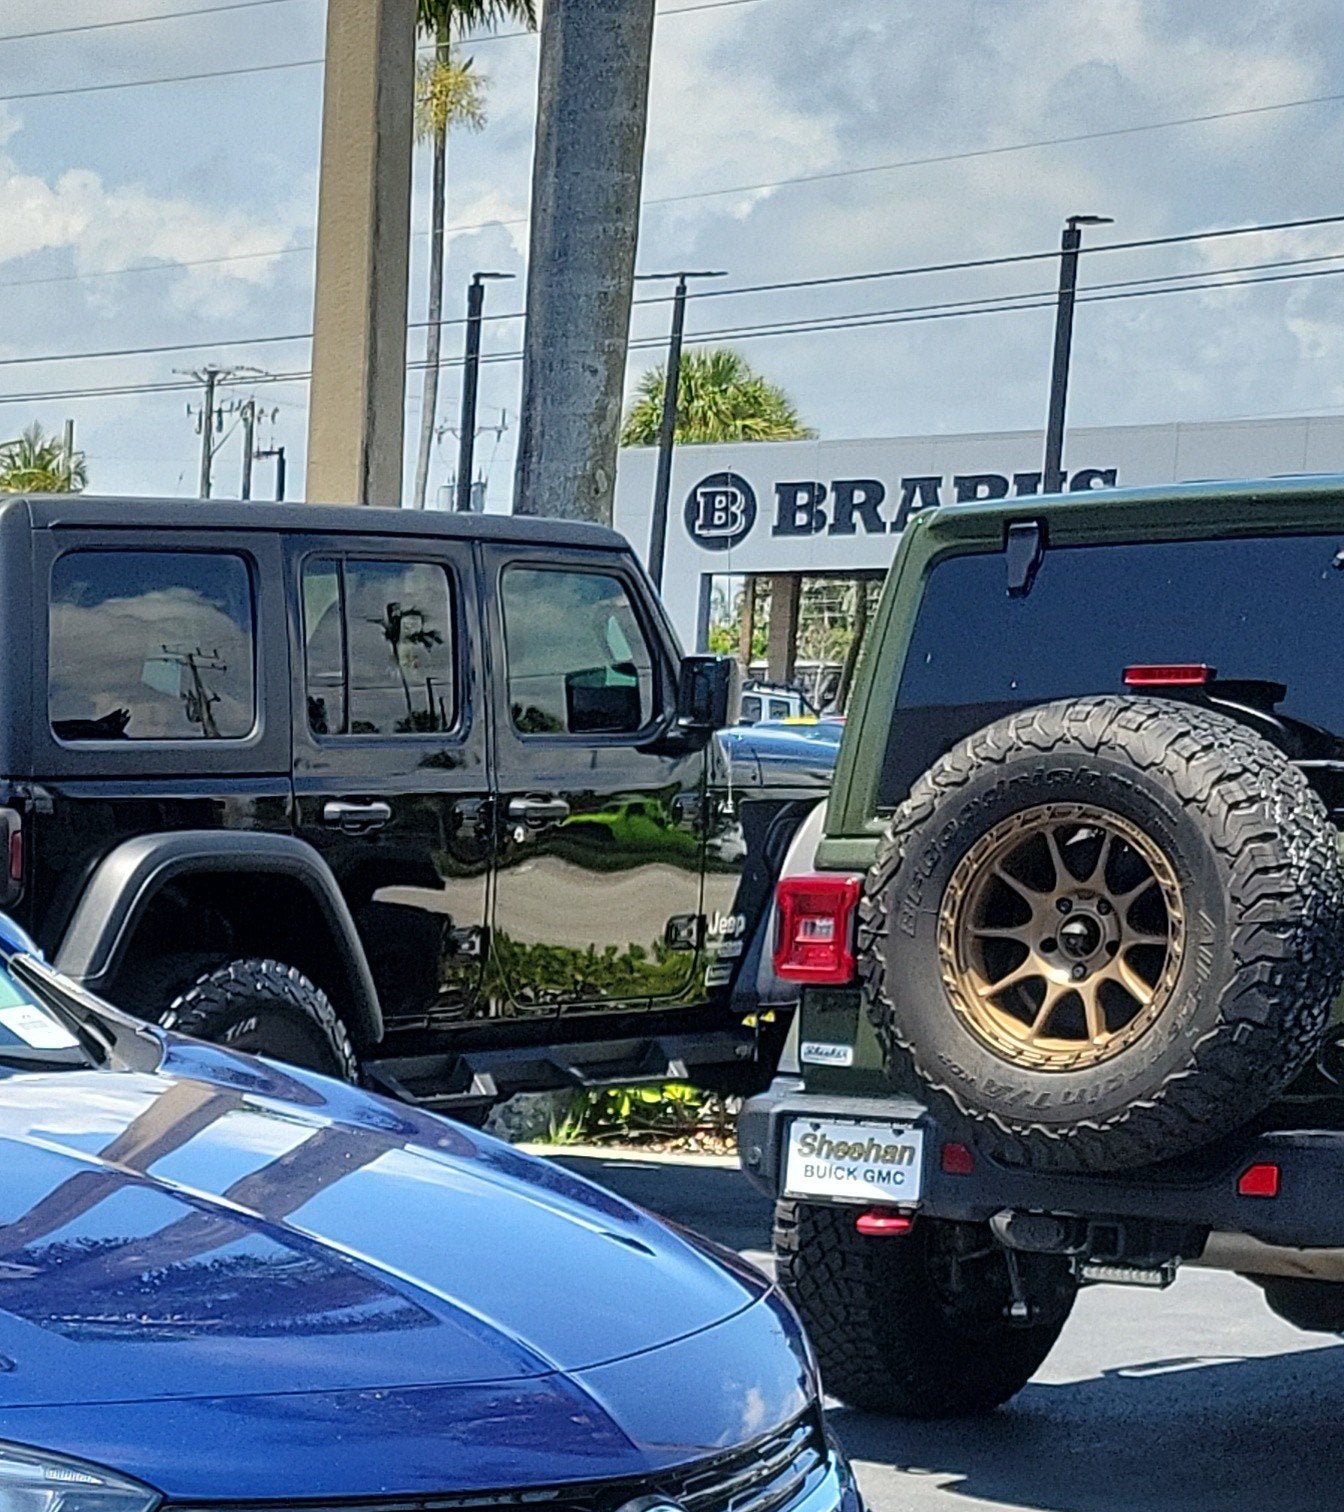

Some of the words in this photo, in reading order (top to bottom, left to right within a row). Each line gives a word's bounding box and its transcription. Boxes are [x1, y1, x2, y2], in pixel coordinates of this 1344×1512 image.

[708, 911, 746, 937] Jeep
[797, 1132, 916, 1166] Sheehan
[804, 1163, 858, 1181] BUICK
[863, 1168, 905, 1186] GMC
